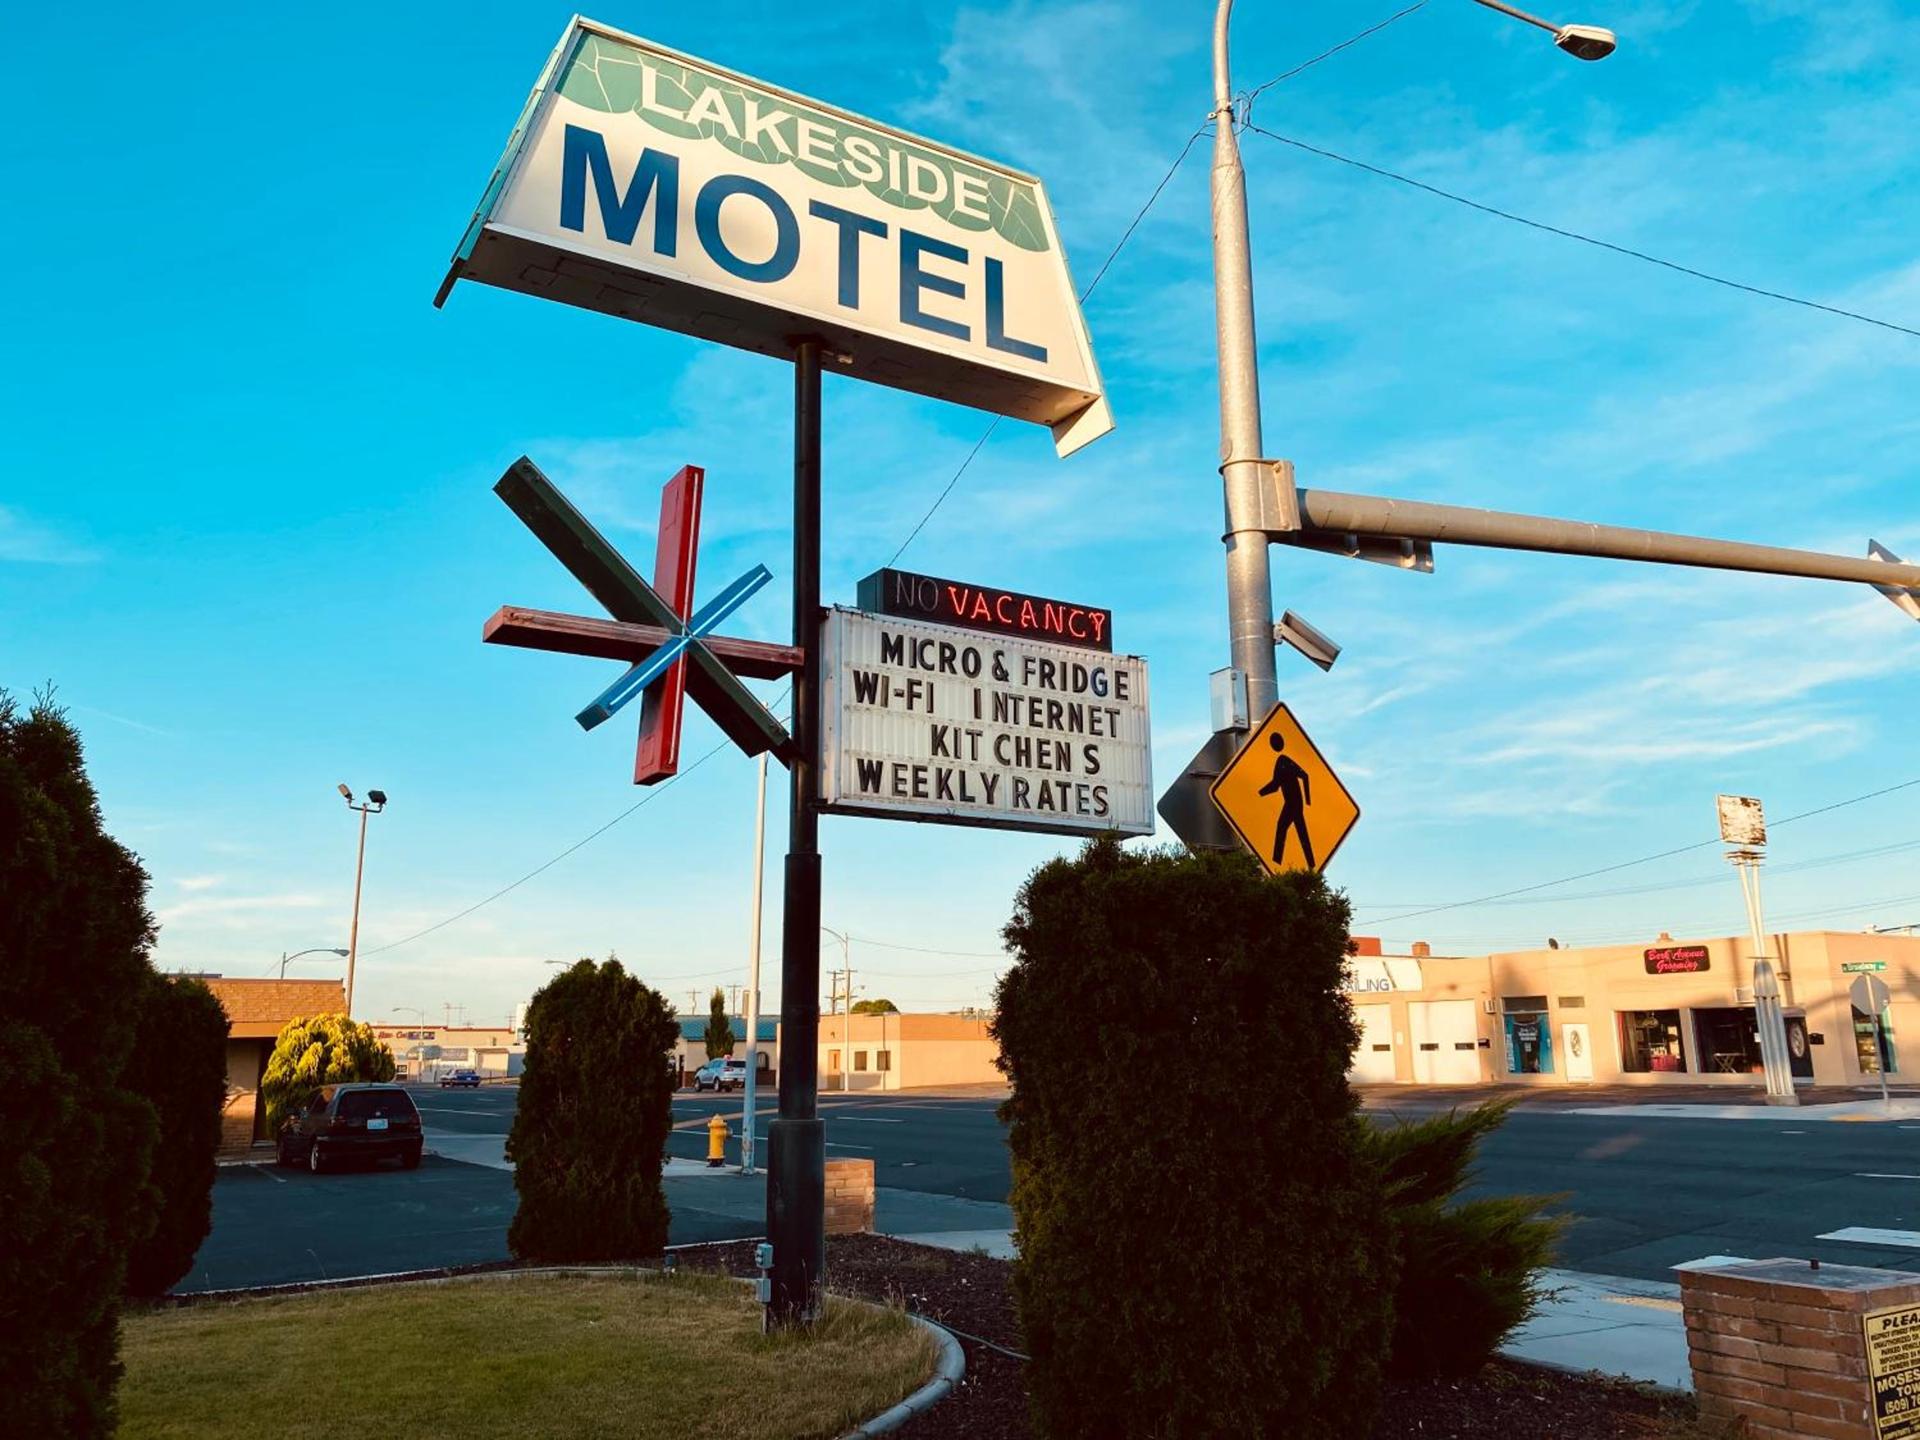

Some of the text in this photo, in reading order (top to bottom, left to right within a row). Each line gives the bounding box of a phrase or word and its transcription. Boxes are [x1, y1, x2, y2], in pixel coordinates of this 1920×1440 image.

[642, 66, 991, 222] LAKESIDE
[559, 124, 1048, 364] MOTEL
[896, 573, 1107, 642] NO VACANCY
[853, 670, 935, 714] WI-FI
[881, 632, 1130, 701] MICRO & FRIDGE
[857, 758, 1110, 817] WEEKLY RATES
[1345, 978, 1390, 992] AILING
[1882, 1313, 1920, 1330] PLEA
[1877, 1369, 1920, 1393] MOSES
[1885, 1397, 1909, 1414] (509)
